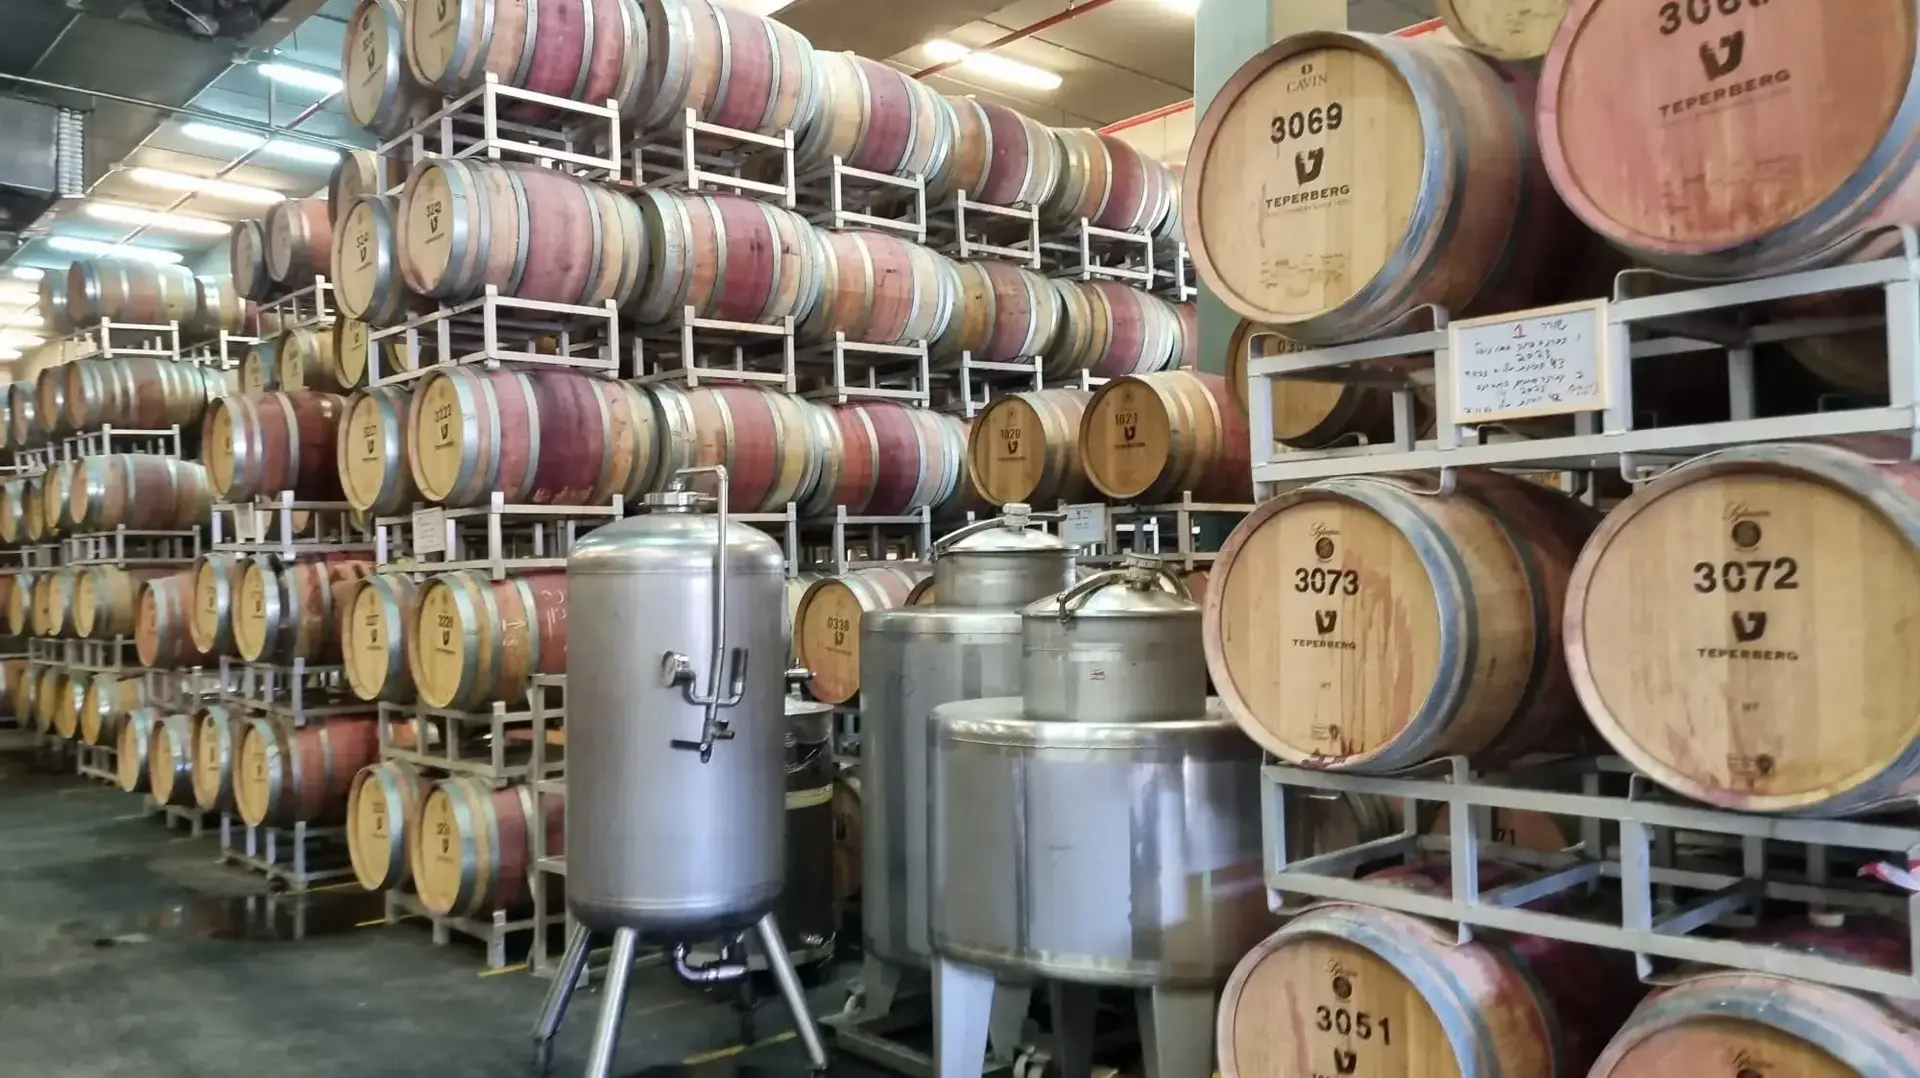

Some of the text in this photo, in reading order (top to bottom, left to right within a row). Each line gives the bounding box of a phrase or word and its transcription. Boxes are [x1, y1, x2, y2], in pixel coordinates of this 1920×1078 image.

[1659, 0, 1768, 35] 306
[1286, 73, 1328, 93] CAVIN
[1658, 69, 1791, 118] TEPERBERG
[1271, 101, 1343, 144] 3069
[1265, 185, 1350, 209] TEPERBERG
[1000, 428, 1021, 440] 1020
[1294, 567, 1360, 596] 3073
[1693, 557, 1800, 594] 3072
[1292, 638, 1357, 651] TEPERBERG
[1696, 648, 1800, 661] TEPERBERG
[1316, 1004, 1391, 1047] 3051
